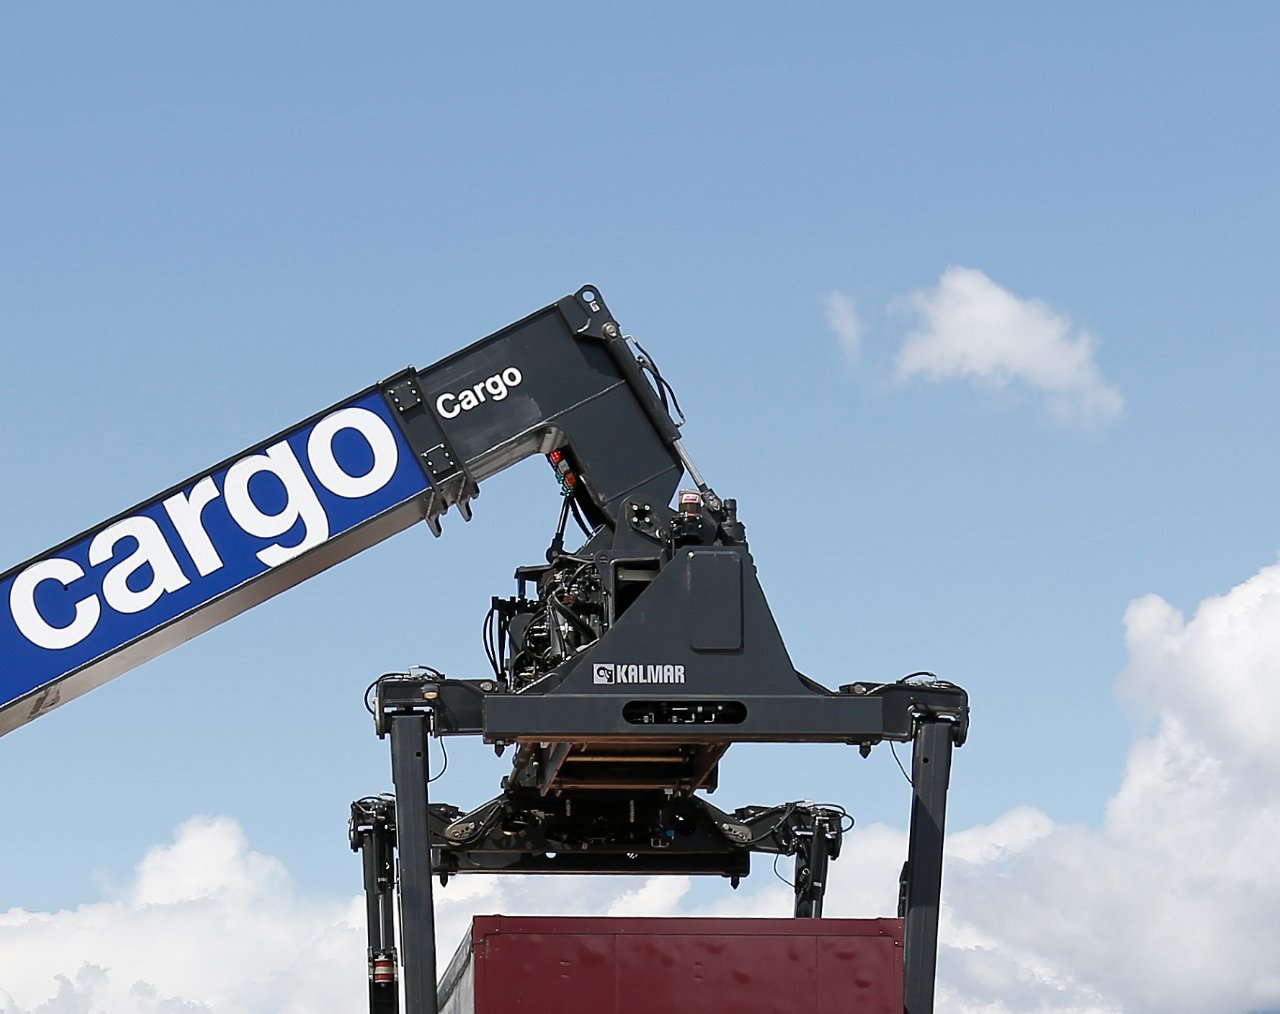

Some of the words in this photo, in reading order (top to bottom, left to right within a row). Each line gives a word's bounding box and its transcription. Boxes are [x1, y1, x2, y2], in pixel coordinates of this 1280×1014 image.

[436, 366, 522, 419] Cargo
[9, 407, 399, 650] cargo
[616, 664, 686, 684] KALMAR
